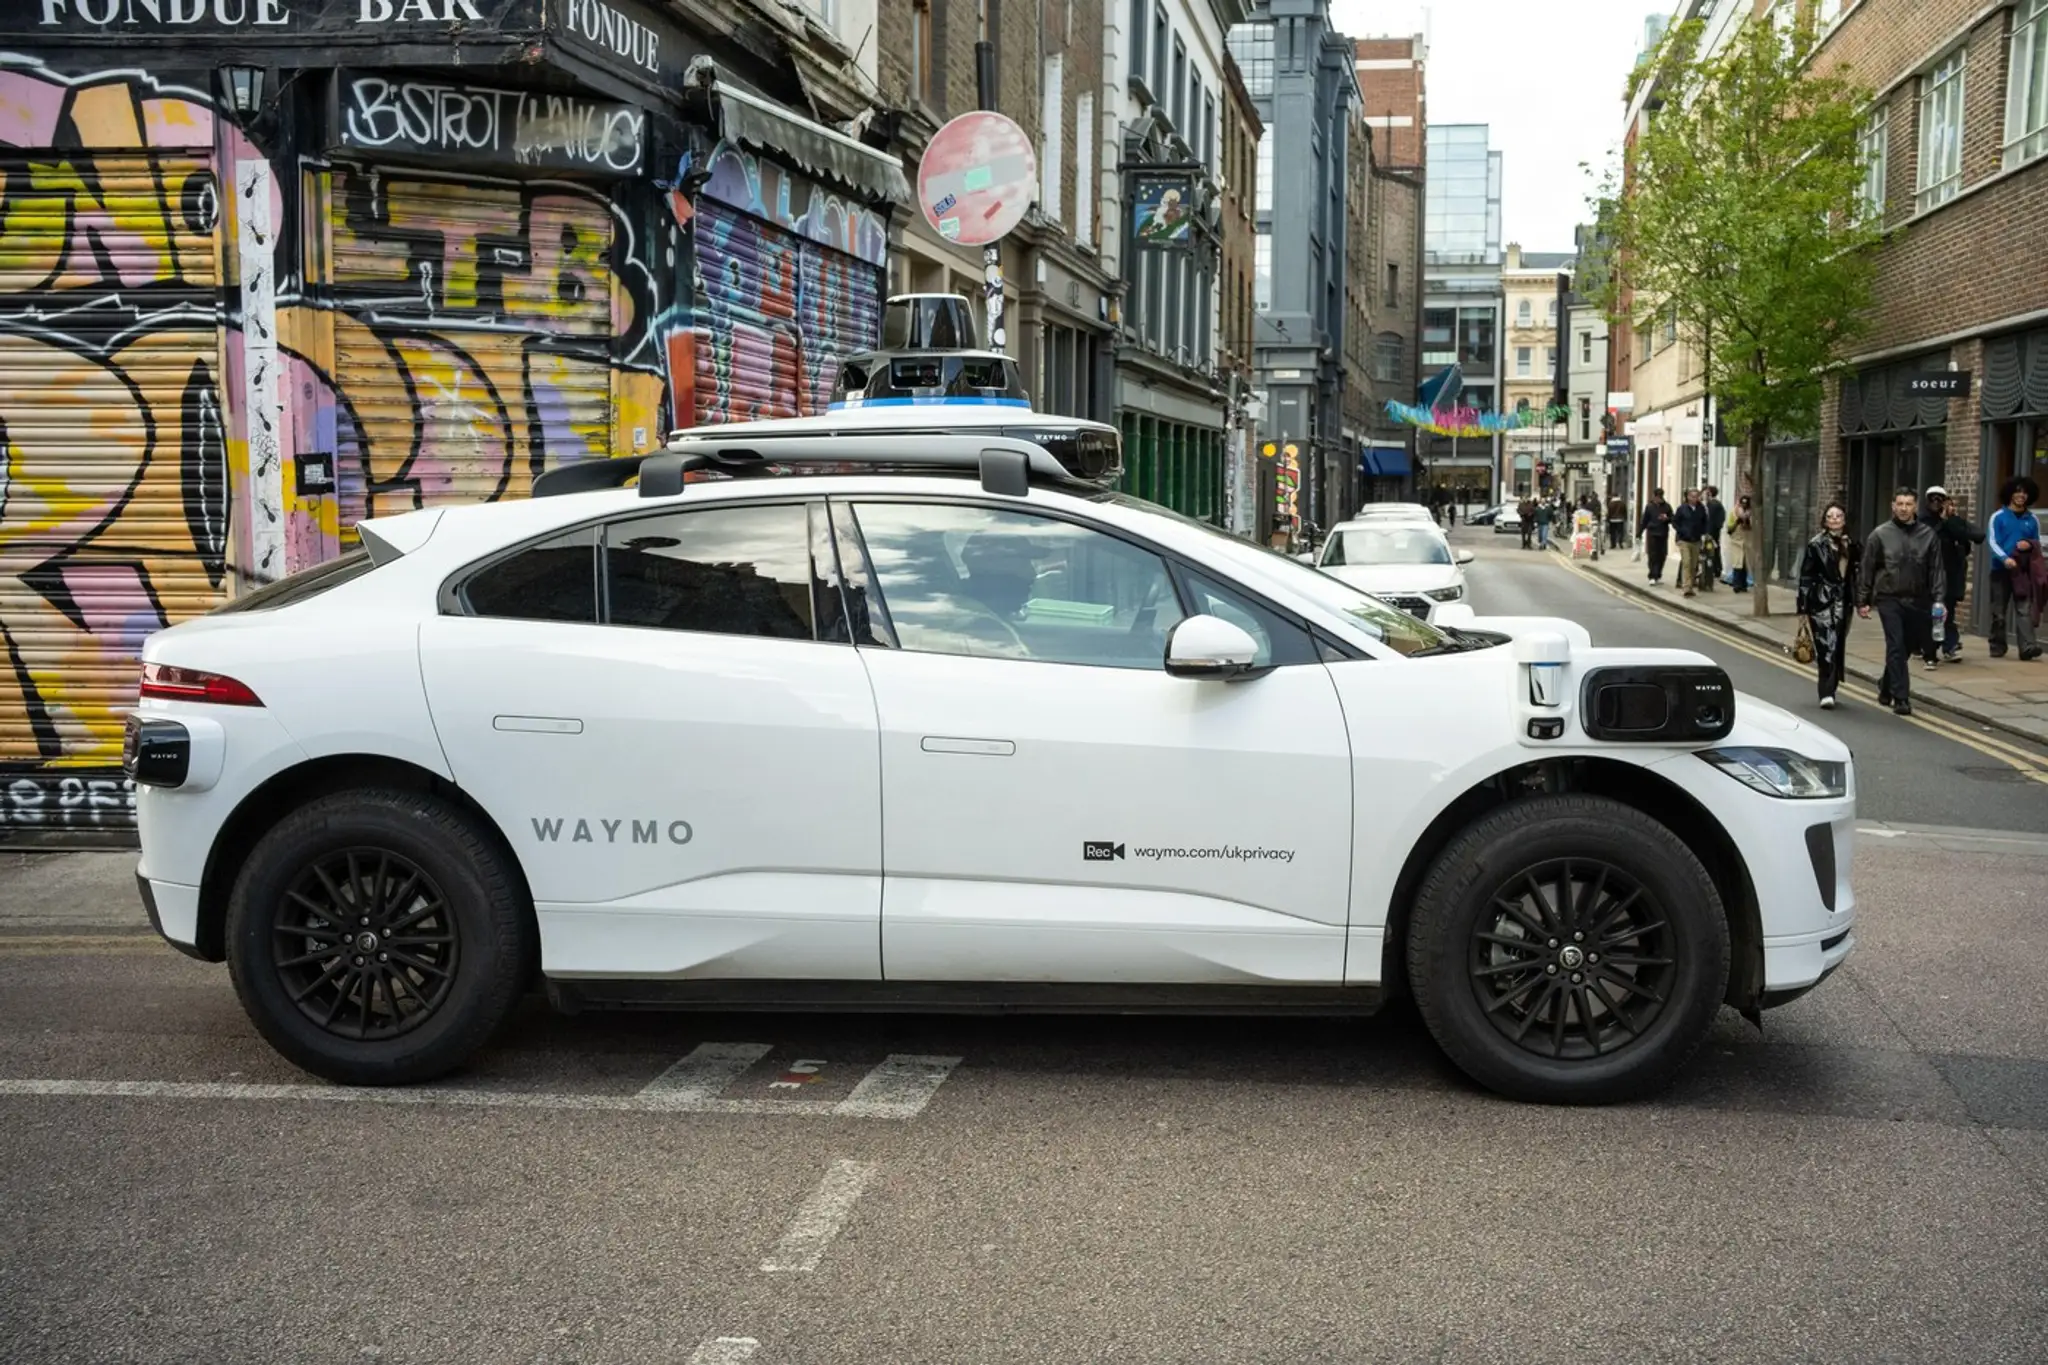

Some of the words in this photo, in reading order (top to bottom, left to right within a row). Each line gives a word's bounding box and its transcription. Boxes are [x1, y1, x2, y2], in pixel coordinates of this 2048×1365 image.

[38, 0, 290, 25] FONDUE
[566, 0, 660, 73] FONDUE
[1911, 380, 1957, 389] soeur
[1033, 433, 1068, 442] WAYMO
[1694, 684, 1723, 692] WAYMO
[150, 752, 179, 760] WAYMO
[530, 817, 694, 846] WAYMO
[1085, 845, 1112, 858] Rec
[1133, 844, 1296, 863] waymo.com/ukprivacy
